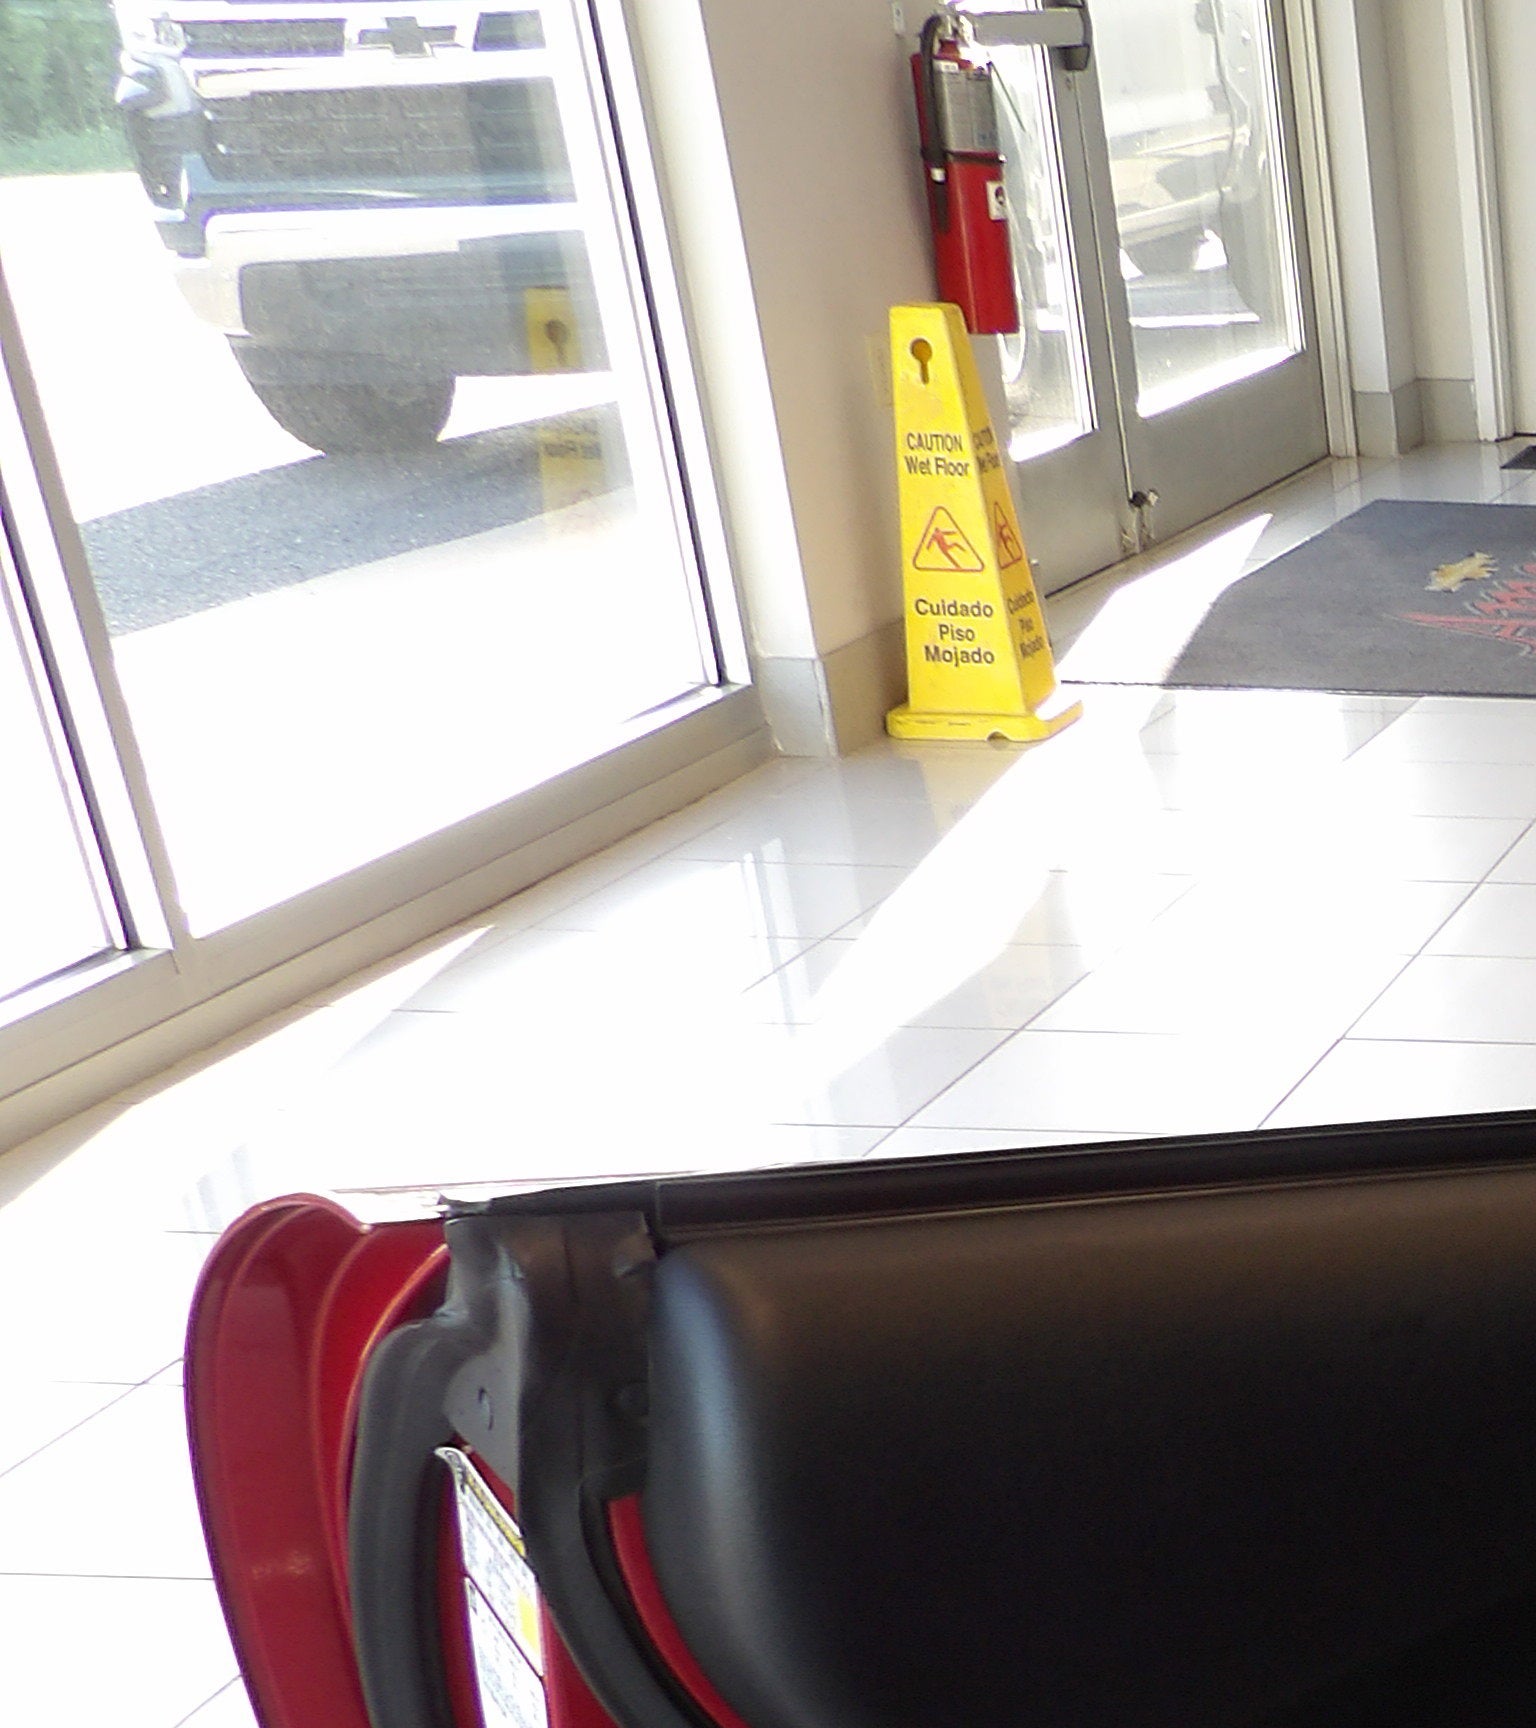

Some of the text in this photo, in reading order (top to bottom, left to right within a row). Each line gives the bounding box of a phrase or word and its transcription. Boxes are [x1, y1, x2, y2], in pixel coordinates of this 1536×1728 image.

[907, 432, 963, 453] CAUTION
[904, 455, 932, 476] Wet
[934, 456, 970, 477] Floor
[915, 598, 994, 618] Cuidado
[938, 623, 975, 642] Piso
[924, 644, 995, 667] Mojado
